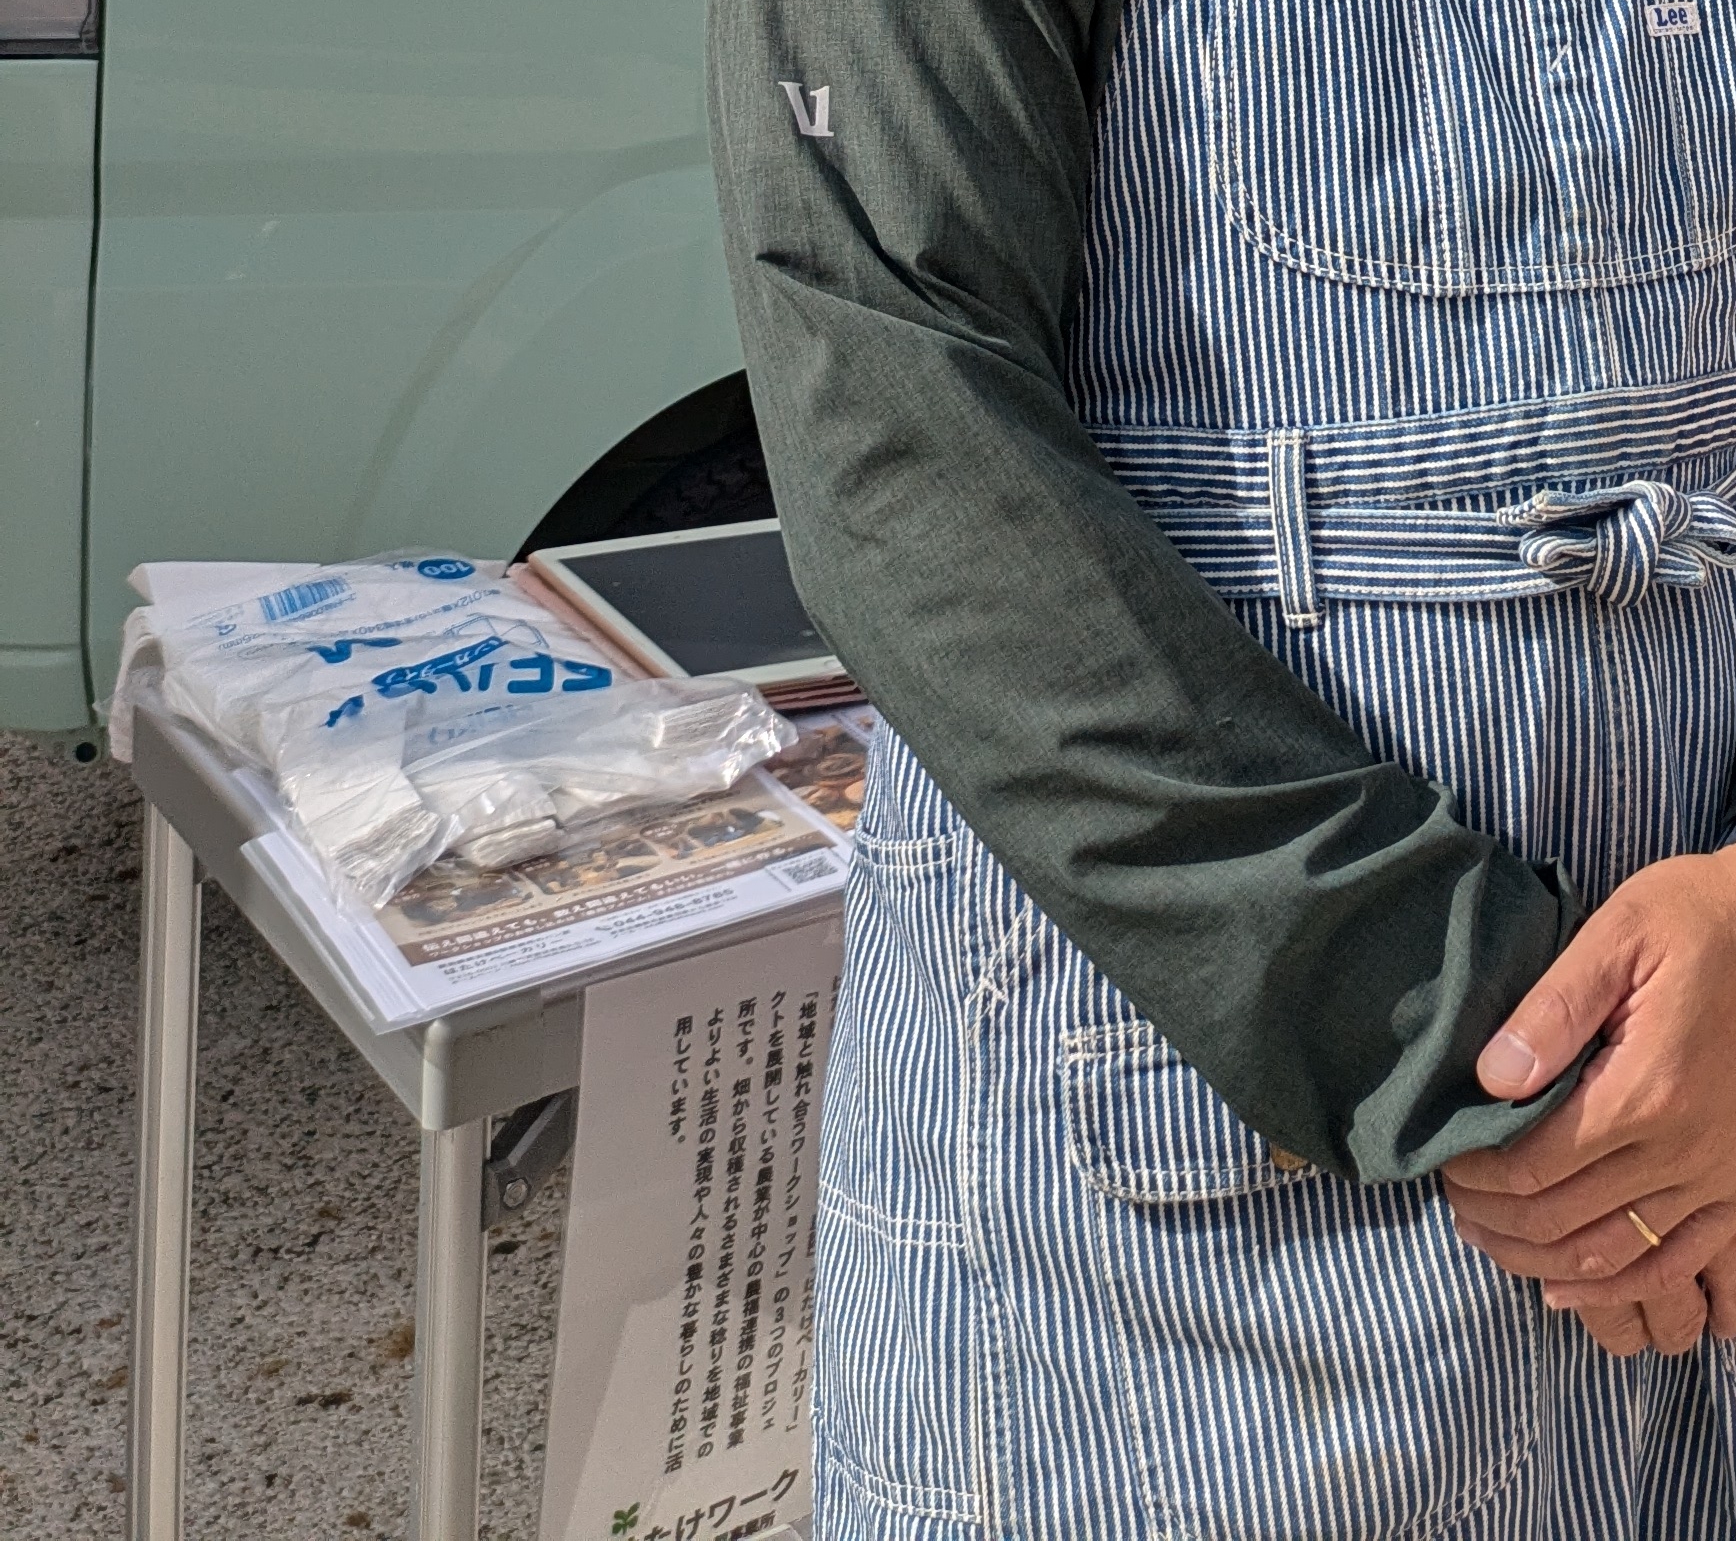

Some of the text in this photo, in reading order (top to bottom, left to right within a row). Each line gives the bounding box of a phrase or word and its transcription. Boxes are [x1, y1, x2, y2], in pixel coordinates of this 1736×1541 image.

[1654, 7, 1688, 27] Lee
[669, 1015, 694, 1144] 用しています。
[628, 1468, 800, 1541] たけワーク
